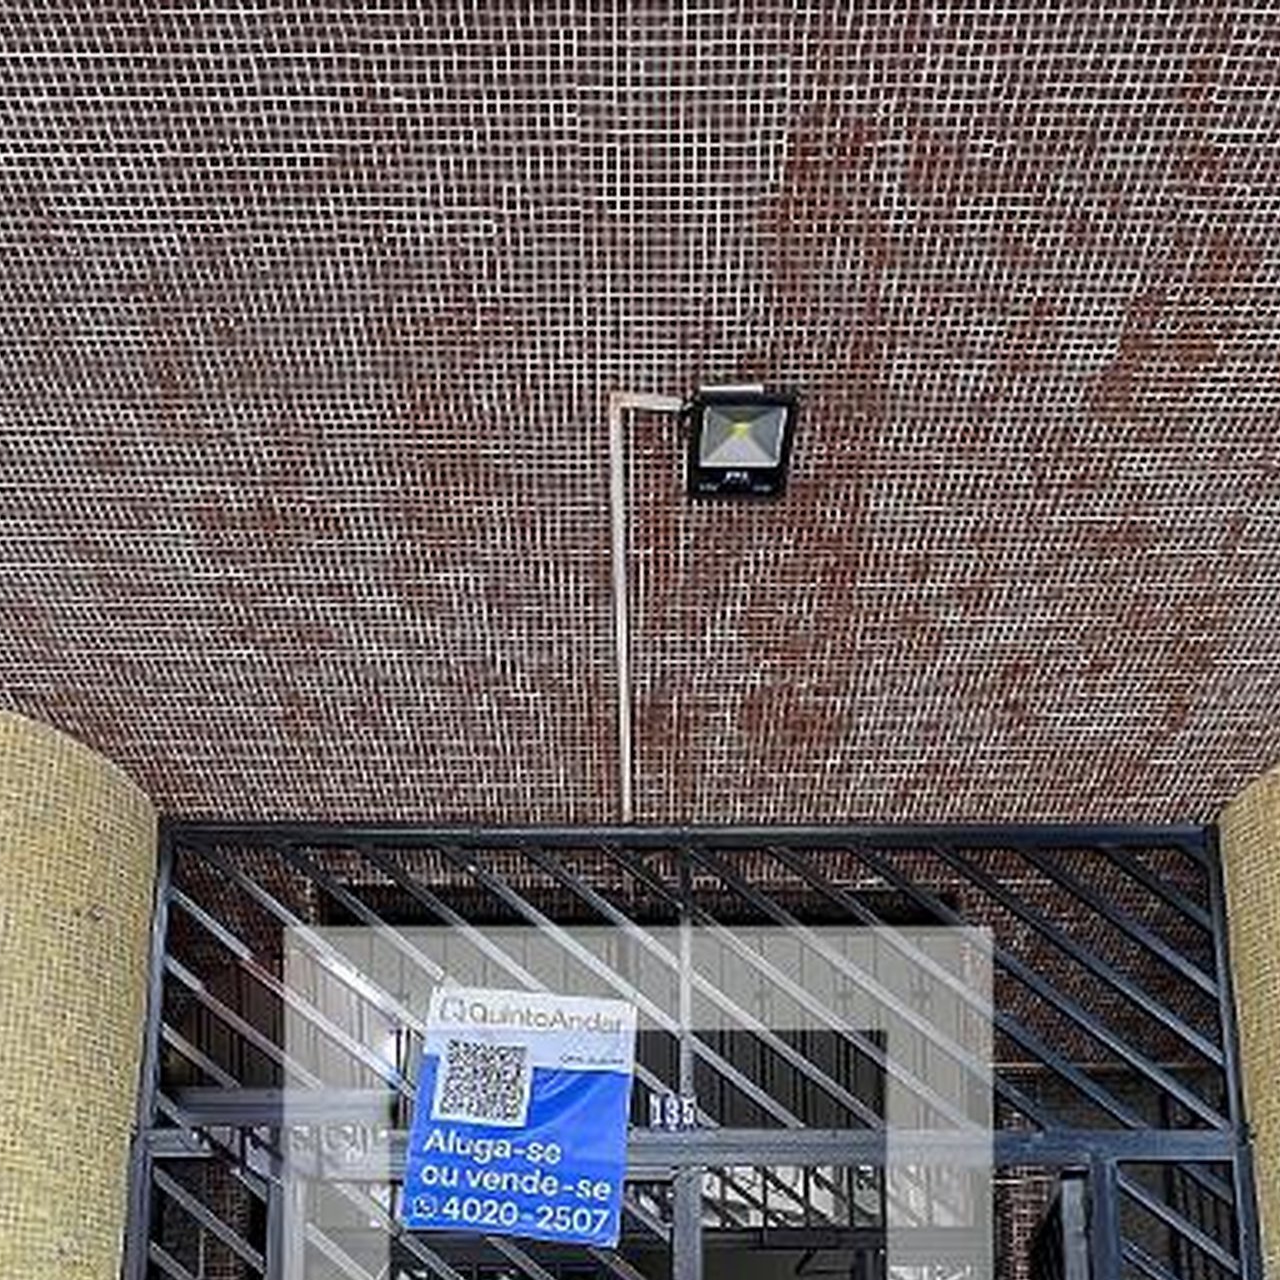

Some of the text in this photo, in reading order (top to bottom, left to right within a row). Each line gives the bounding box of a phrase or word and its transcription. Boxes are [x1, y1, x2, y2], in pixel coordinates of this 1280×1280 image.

[469, 1002, 622, 1033] QuintoAndar
[422, 1129, 562, 1164] Aluga-se
[421, 1165, 612, 1199] ou vende-se
[442, 1197, 610, 1234] 4020-2507
